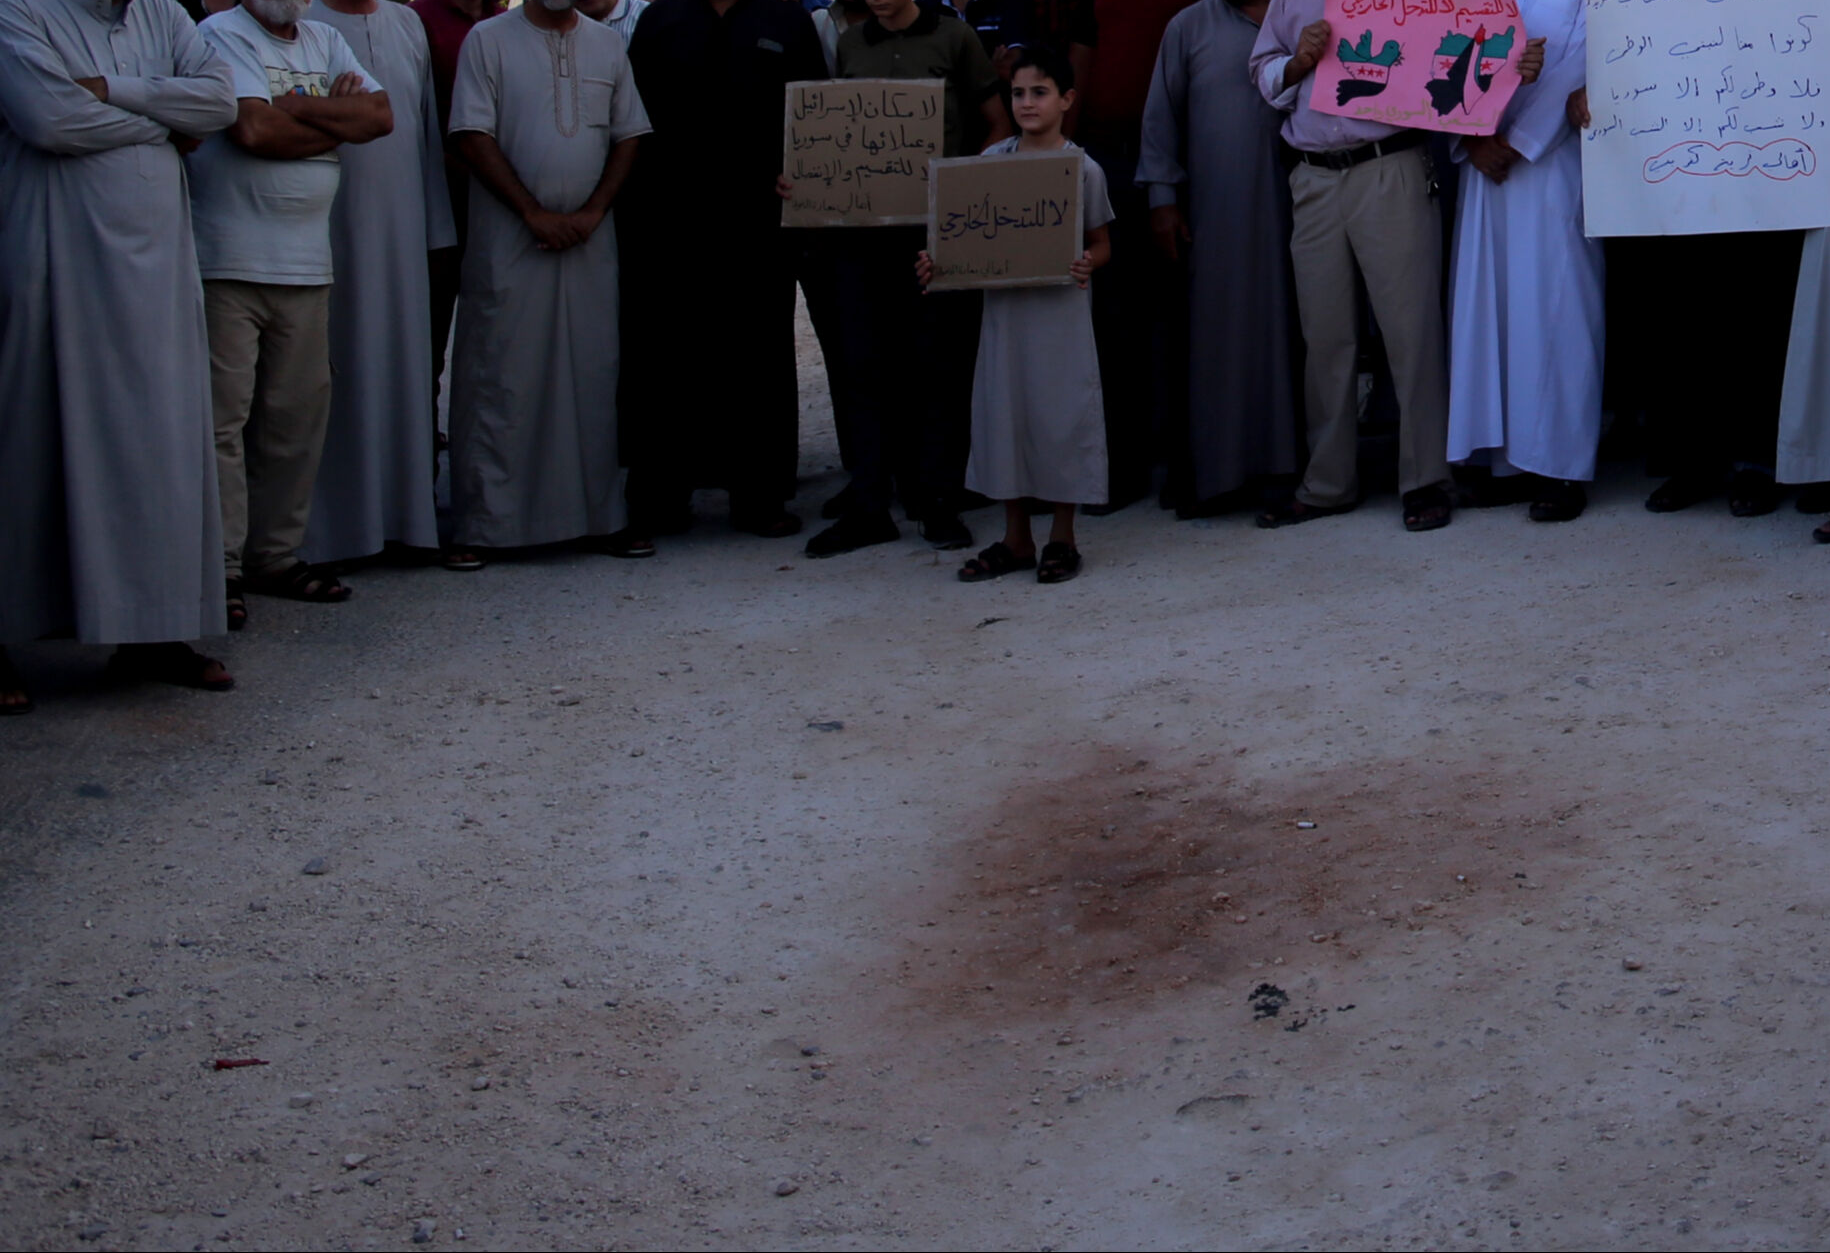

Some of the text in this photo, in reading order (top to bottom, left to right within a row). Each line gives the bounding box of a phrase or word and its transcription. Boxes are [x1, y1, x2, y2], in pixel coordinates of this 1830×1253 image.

[1506, 0, 1519, 18] لا
[1769, 15, 1818, 54] كونوا
[864, 89, 914, 119] مكان
[919, 94, 936, 121] لا
[1611, 83, 1657, 105] سوريا
[791, 124, 936, 156] وعملائها في سوريا
[856, 156, 913, 189] للتقسيم
[983, 197, 1045, 240] للتدخل
[1049, 197, 1068, 226] لا
